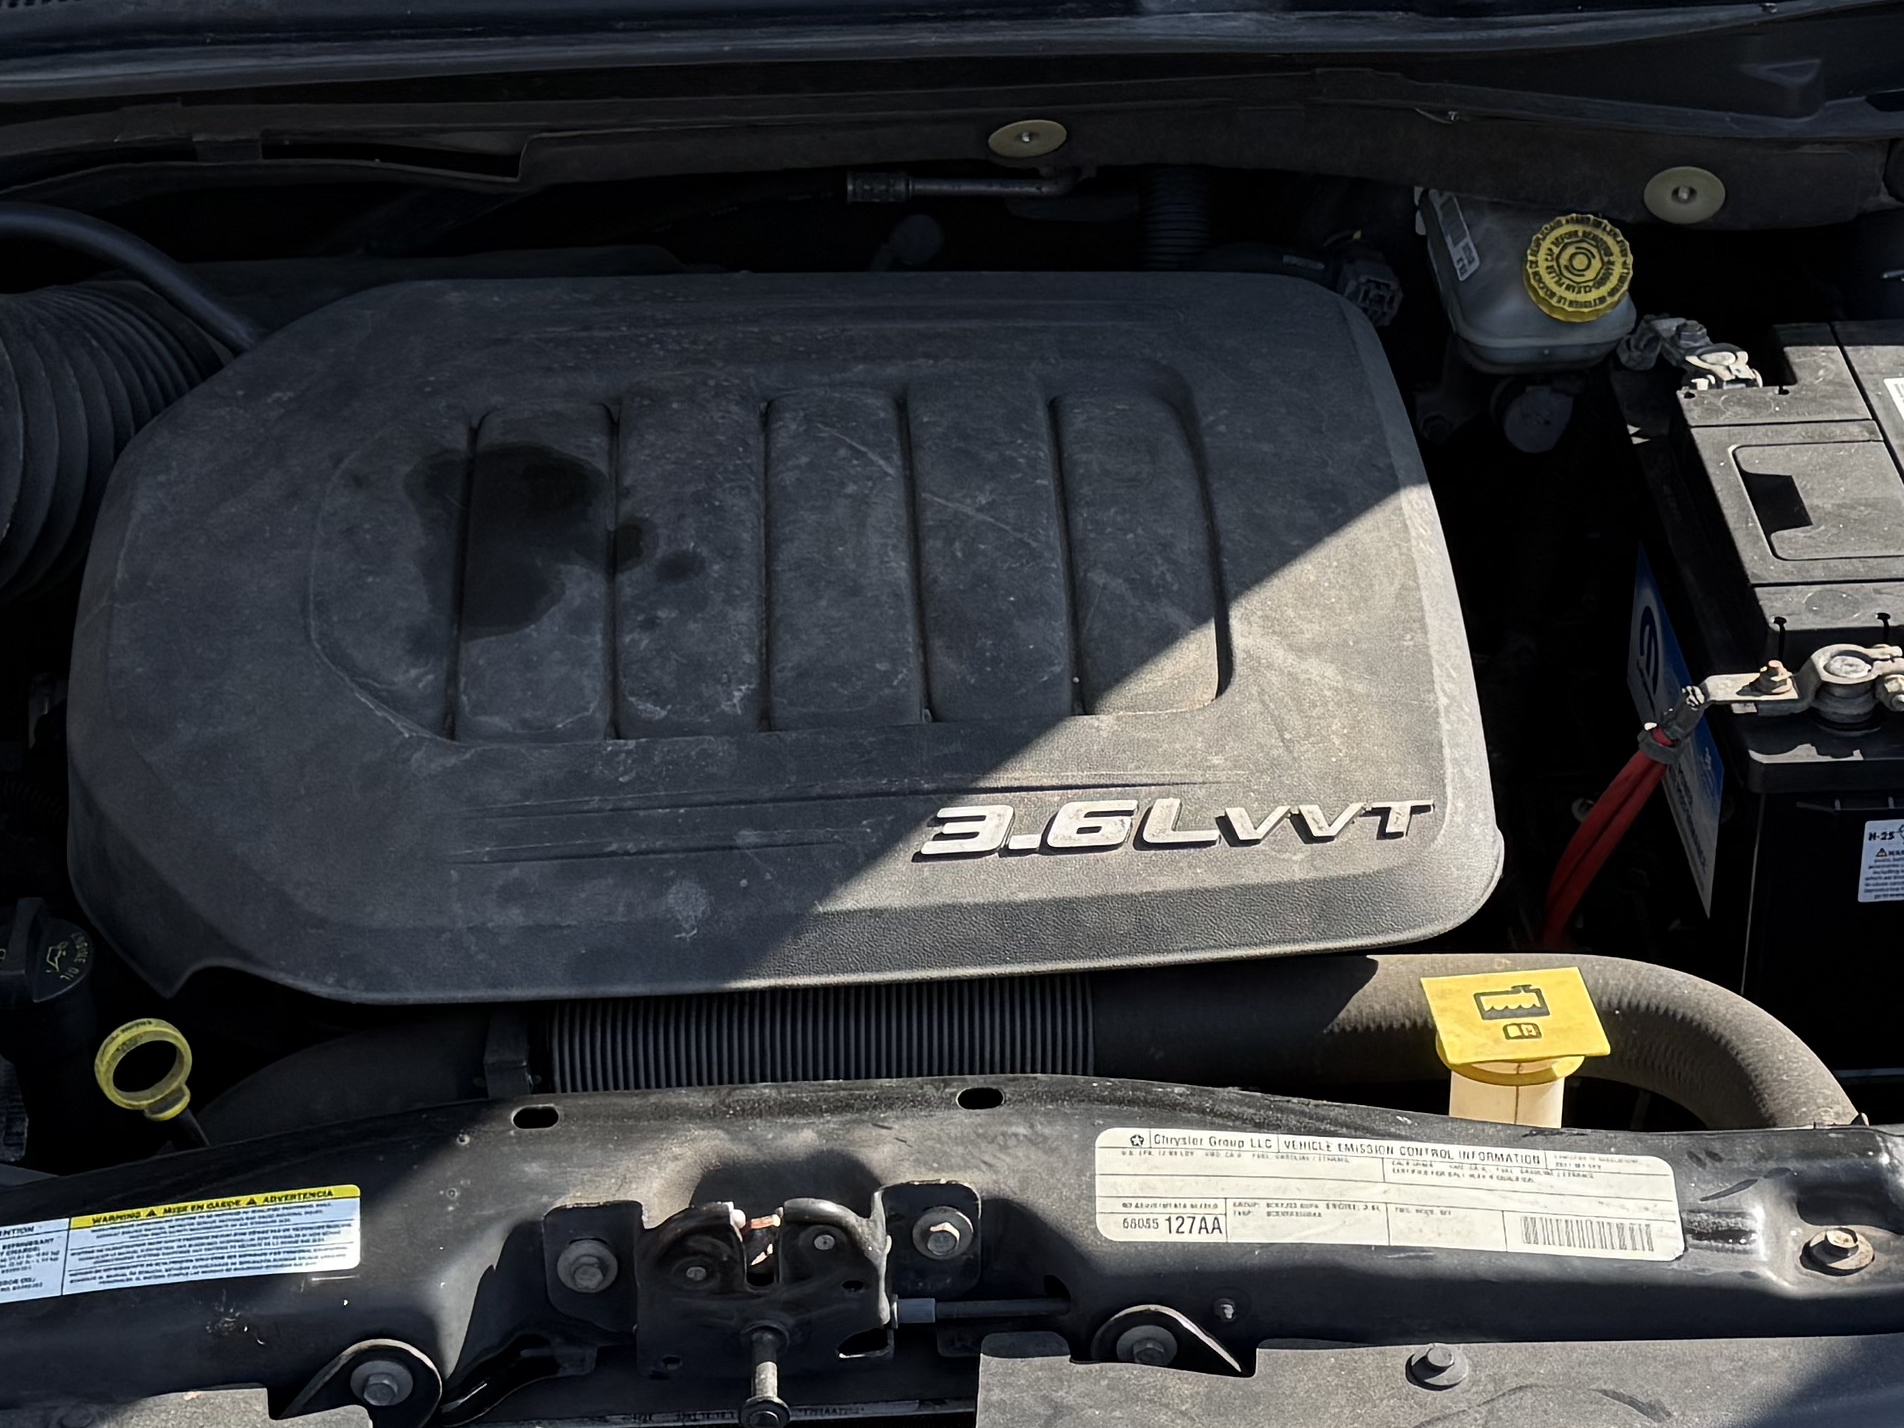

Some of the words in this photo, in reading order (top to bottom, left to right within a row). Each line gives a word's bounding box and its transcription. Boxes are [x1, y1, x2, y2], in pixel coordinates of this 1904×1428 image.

[1153, 1133, 1203, 1147] Chrysler
[1209, 1135, 1245, 1149] Group
[1250, 1137, 1273, 1149] LLC
[1284, 1138, 1332, 1152] VEHICLE
[1338, 1143, 1394, 1155] EMISSION
[1399, 1146, 1454, 1160] CONTROL
[1458, 1149, 1541, 1165] INFORMATION
[262, 1189, 334, 1205] ADVERTENCIA
[1164, 1215, 1223, 1235] 127AA
